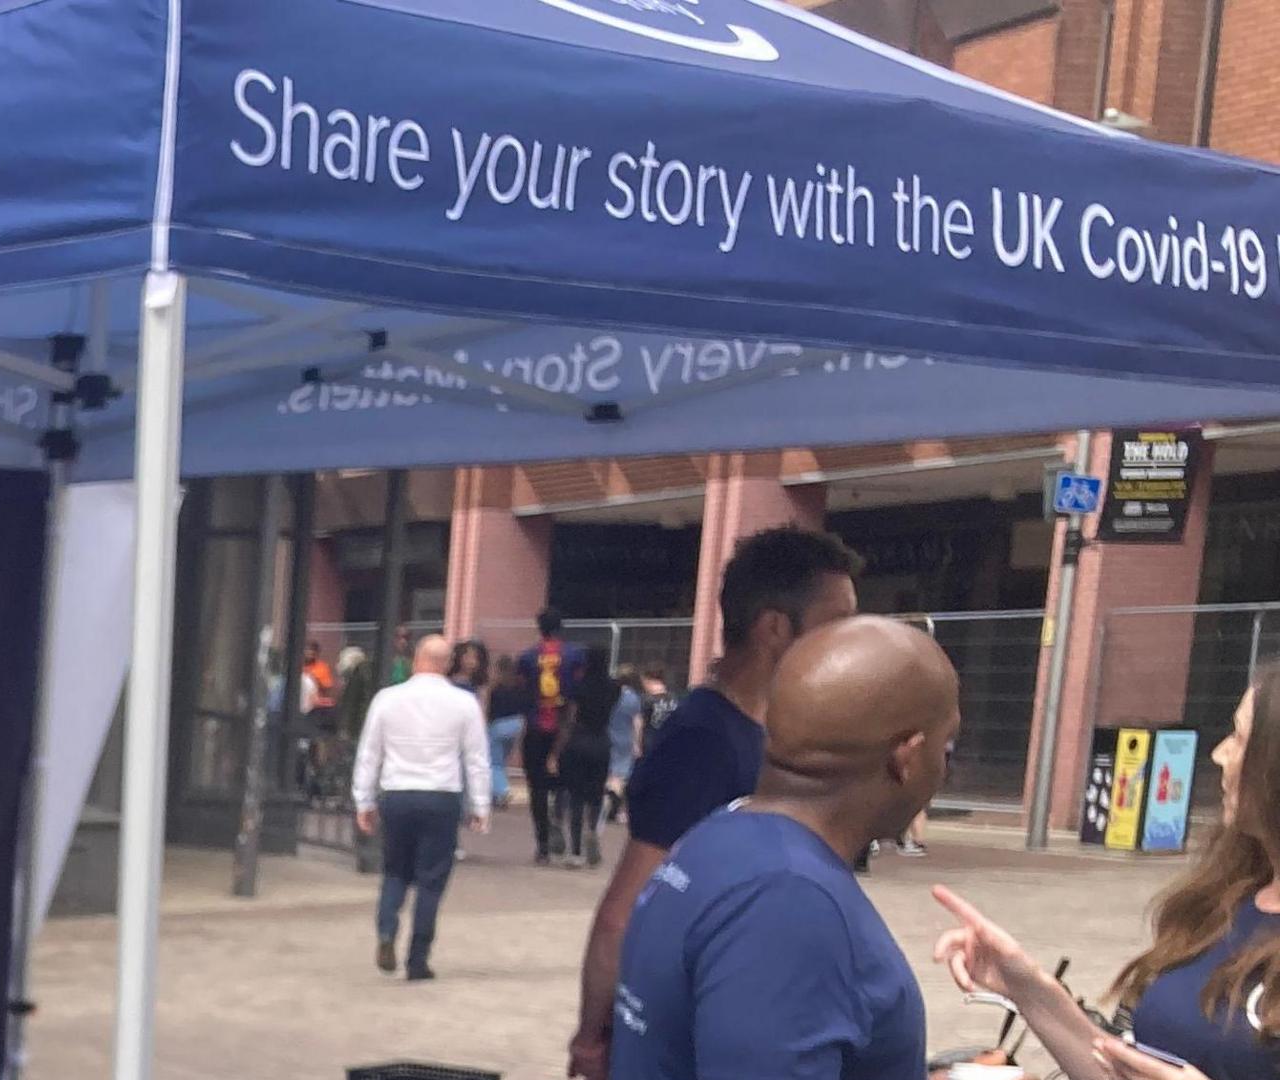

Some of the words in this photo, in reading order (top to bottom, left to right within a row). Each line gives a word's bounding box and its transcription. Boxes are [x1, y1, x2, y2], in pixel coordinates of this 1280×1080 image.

[229, 68, 431, 191] Share
[445, 127, 592, 222] your
[604, 140, 753, 254] story
[766, 163, 875, 248] with
[891, 174, 975, 260] the
[991, 186, 1066, 273] UK
[1079, 203, 1268, 300] Covid-19
